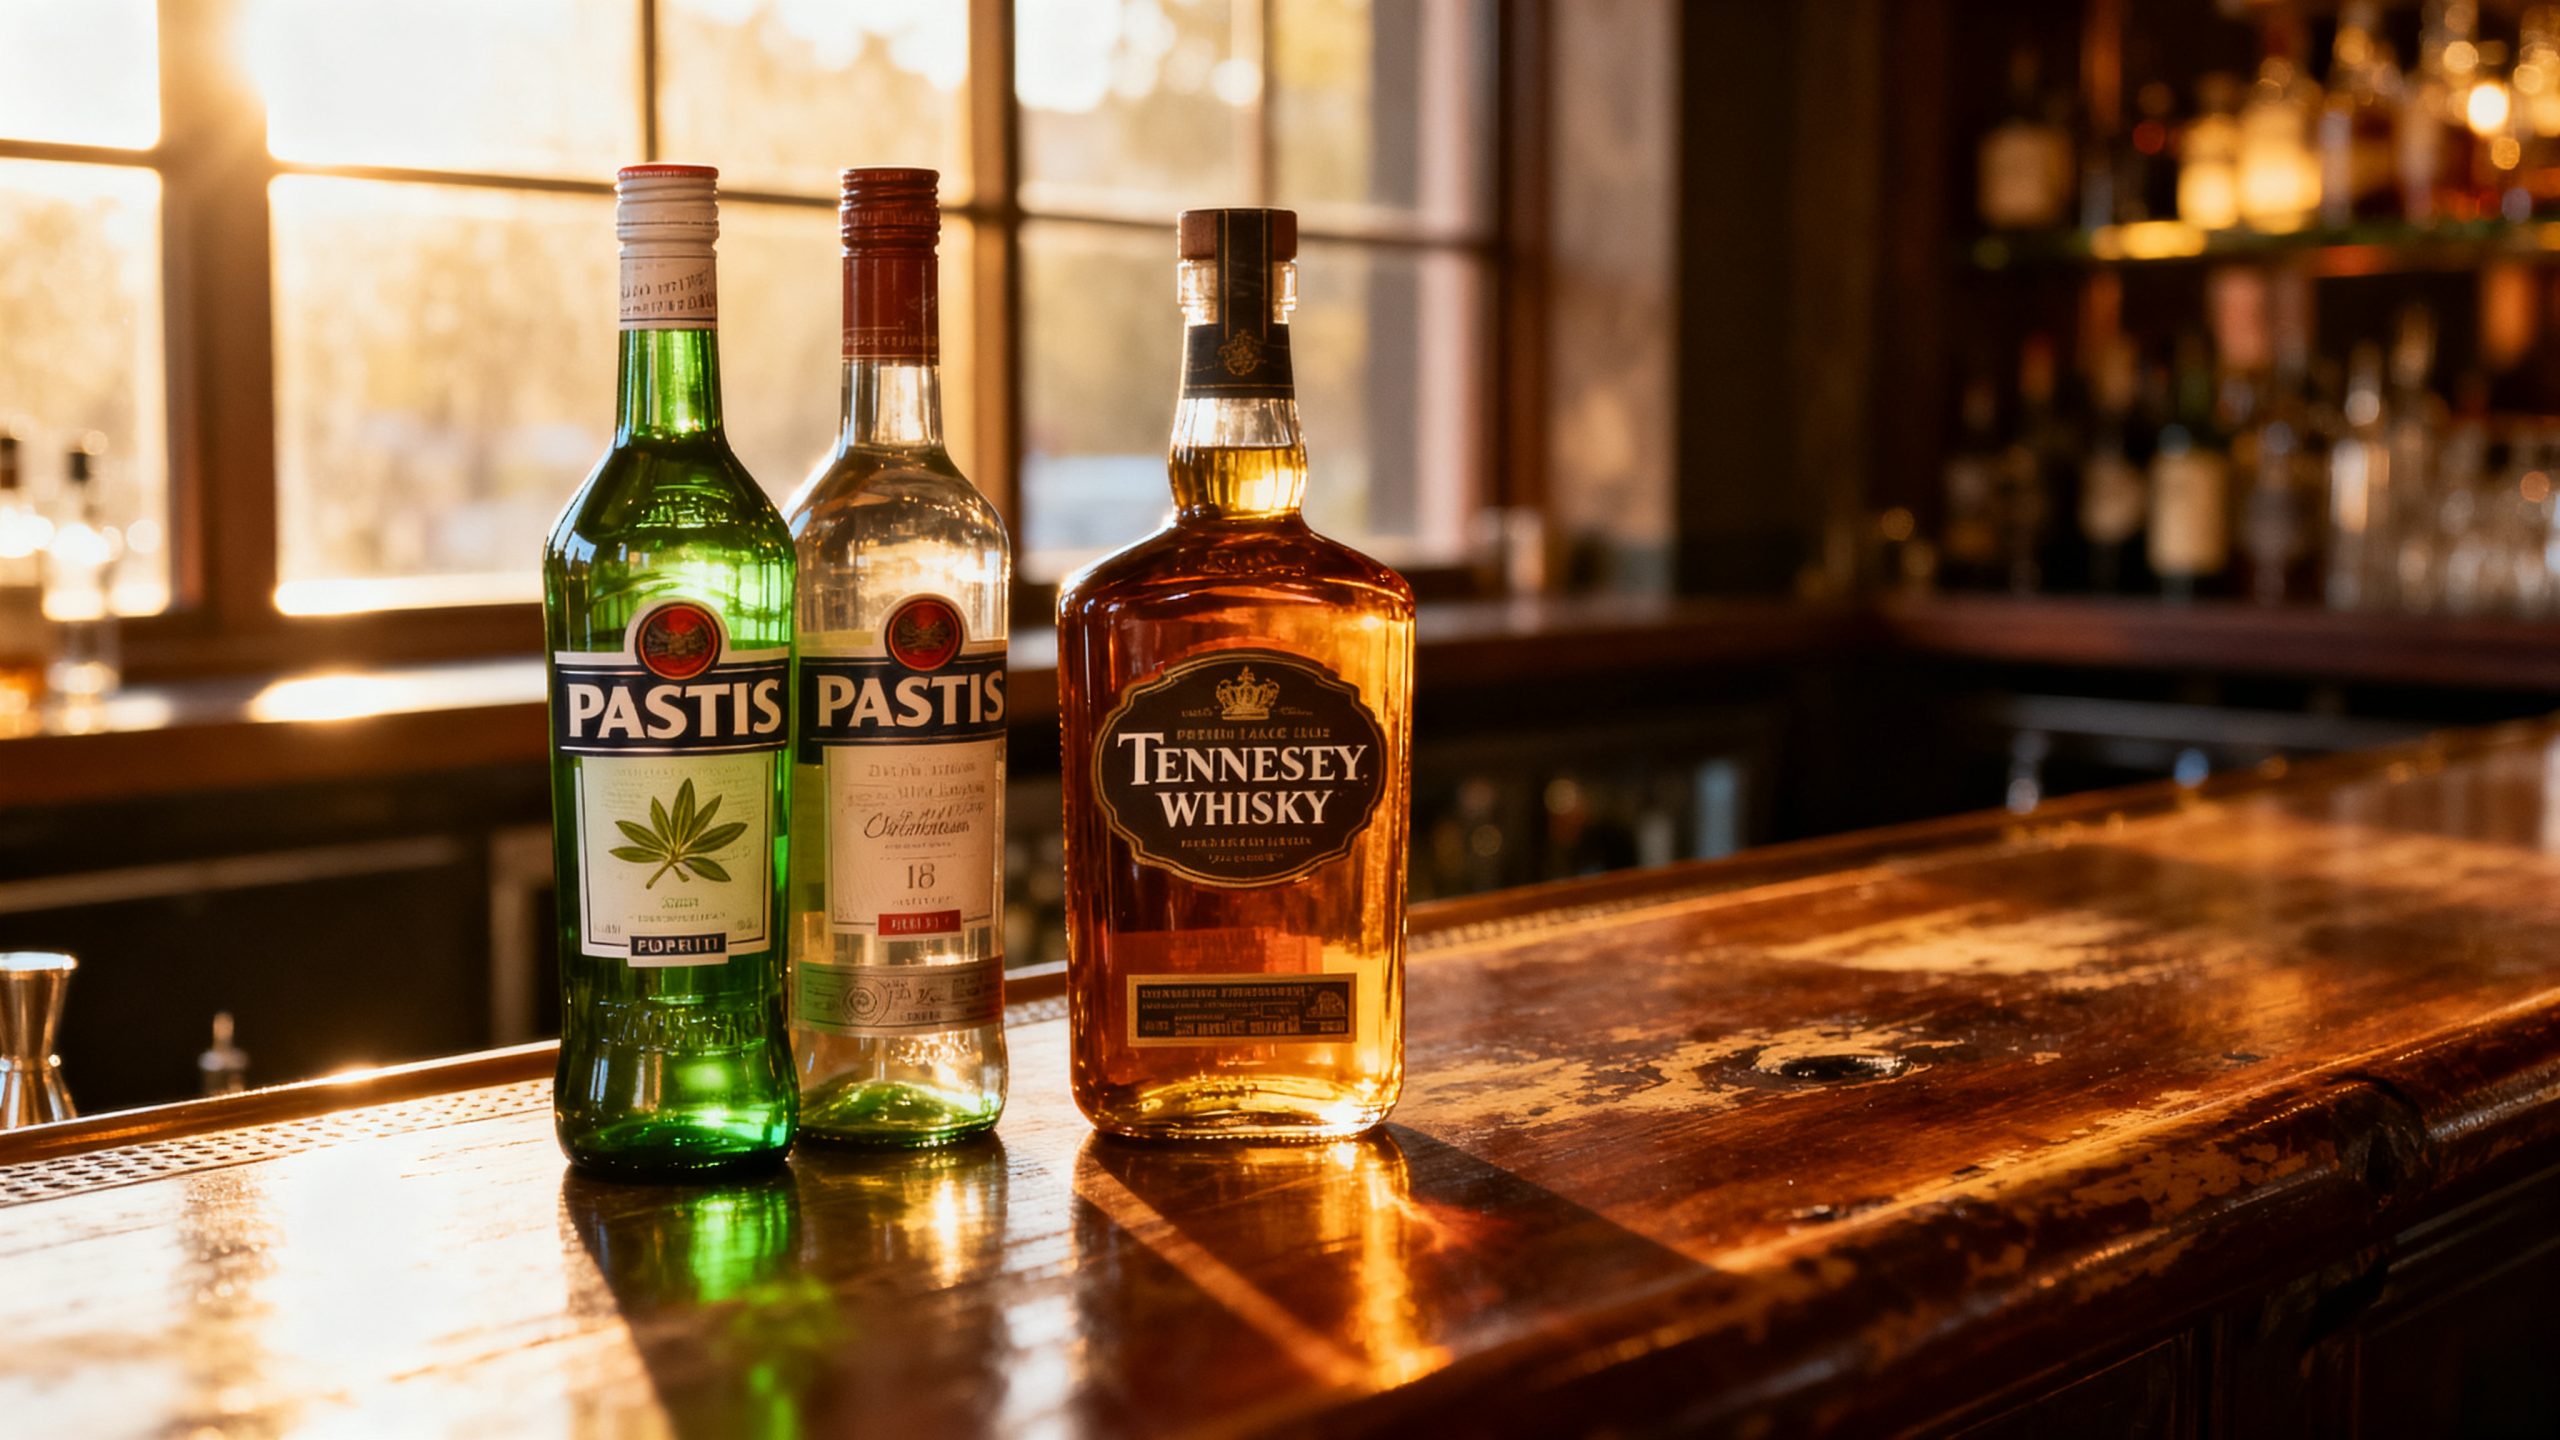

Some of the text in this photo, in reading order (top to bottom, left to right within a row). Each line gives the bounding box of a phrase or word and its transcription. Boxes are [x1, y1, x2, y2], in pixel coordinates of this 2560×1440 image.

[567, 677, 782, 740] PASTIS
[816, 670, 1005, 729] PASTIS
[1117, 731, 1368, 786] TENNESEY
[1155, 788, 1334, 829] WHISKY
[907, 861, 936, 890] 18
